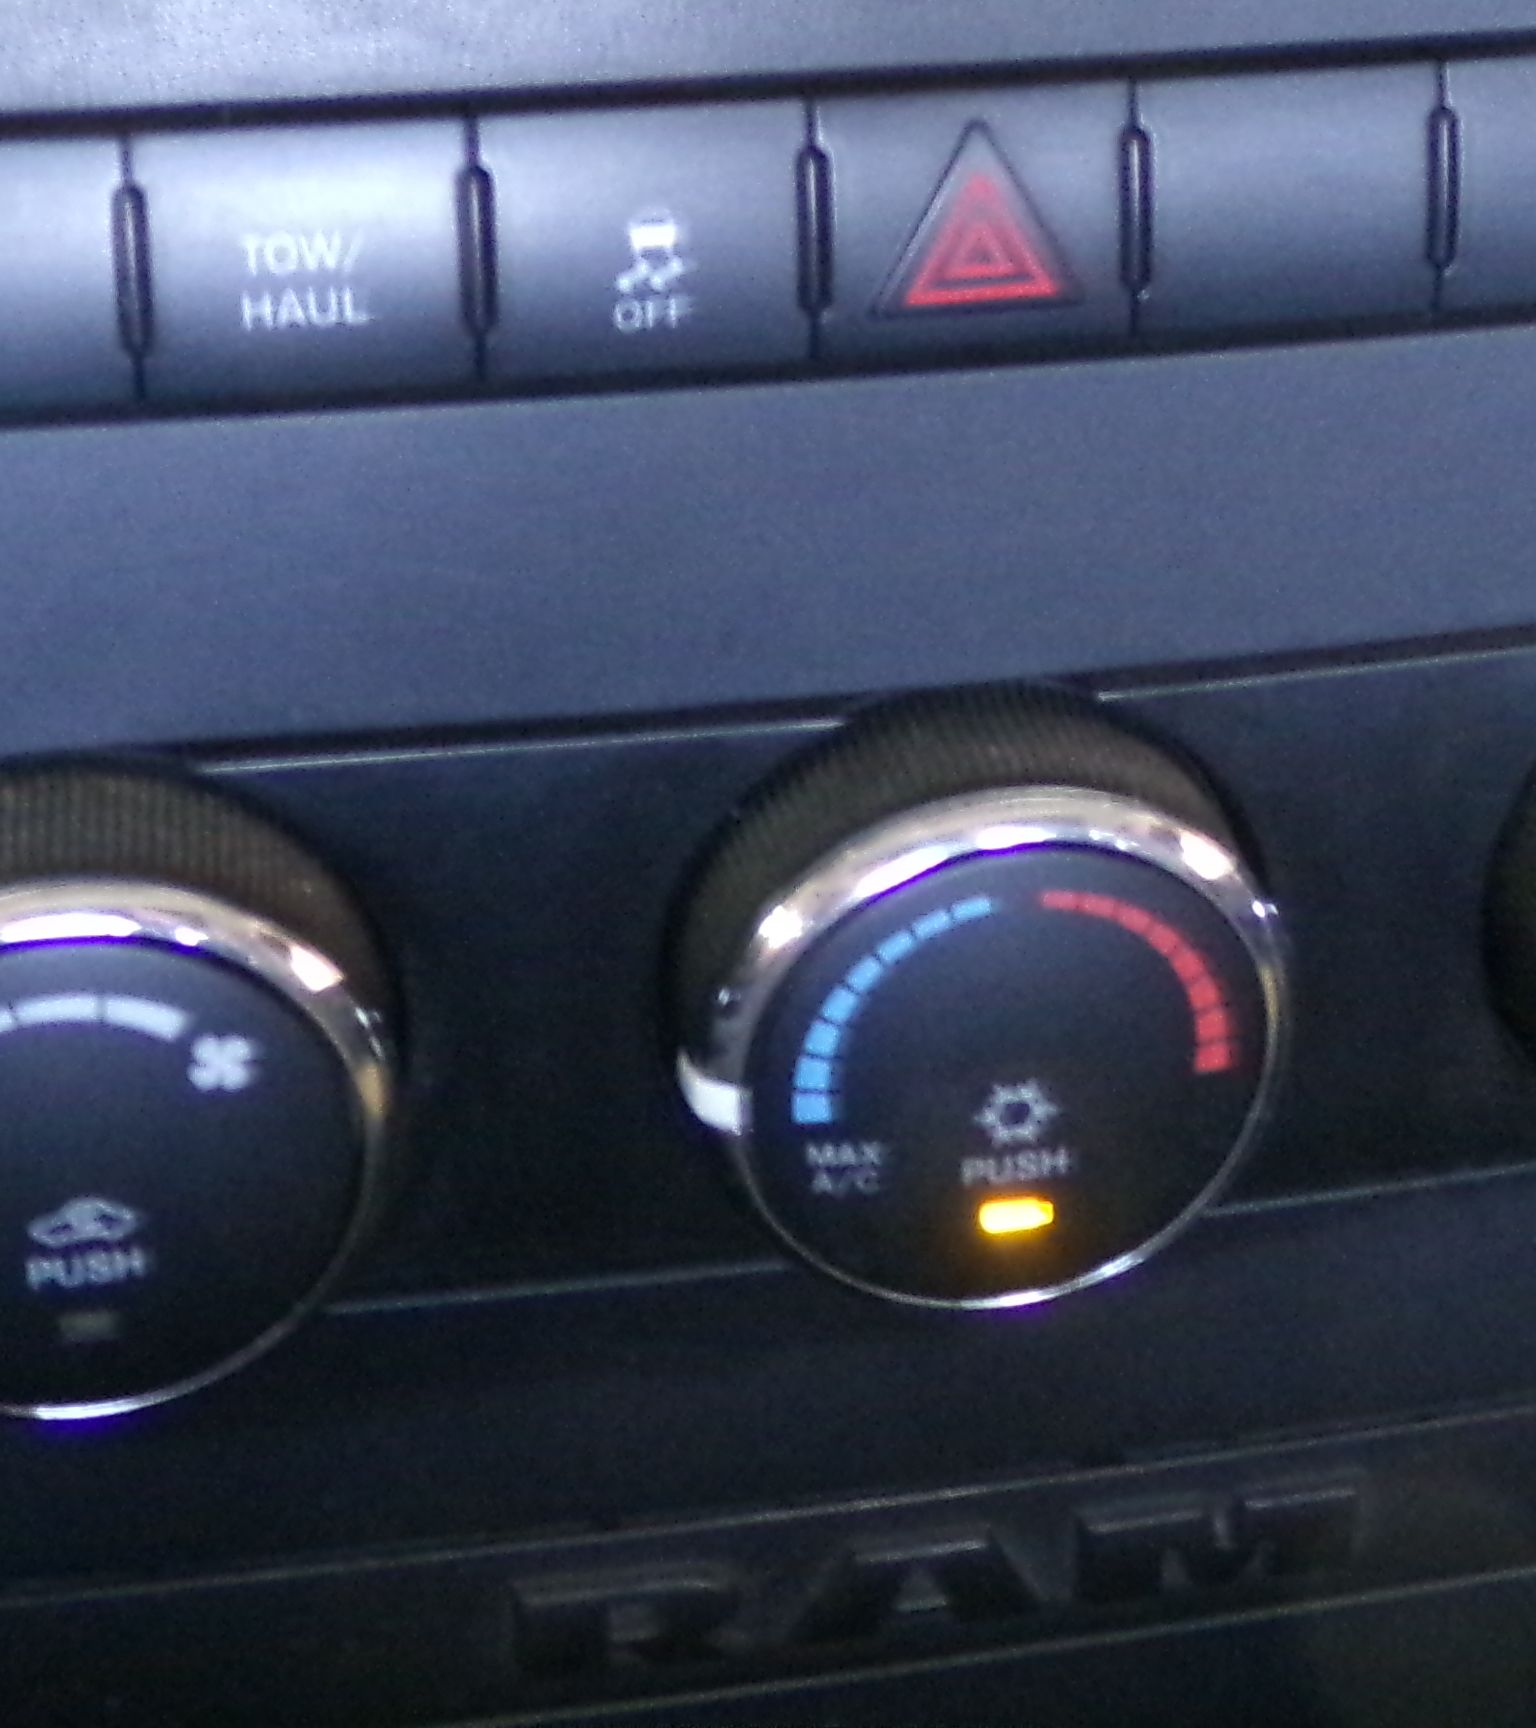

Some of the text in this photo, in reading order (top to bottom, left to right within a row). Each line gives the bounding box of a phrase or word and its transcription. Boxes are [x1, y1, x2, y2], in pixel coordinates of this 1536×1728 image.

[239, 285, 372, 333] HAUL
[612, 295, 696, 333] OFF
[960, 1145, 1073, 1187] PUSH
[24, 1245, 150, 1291] PUSH
